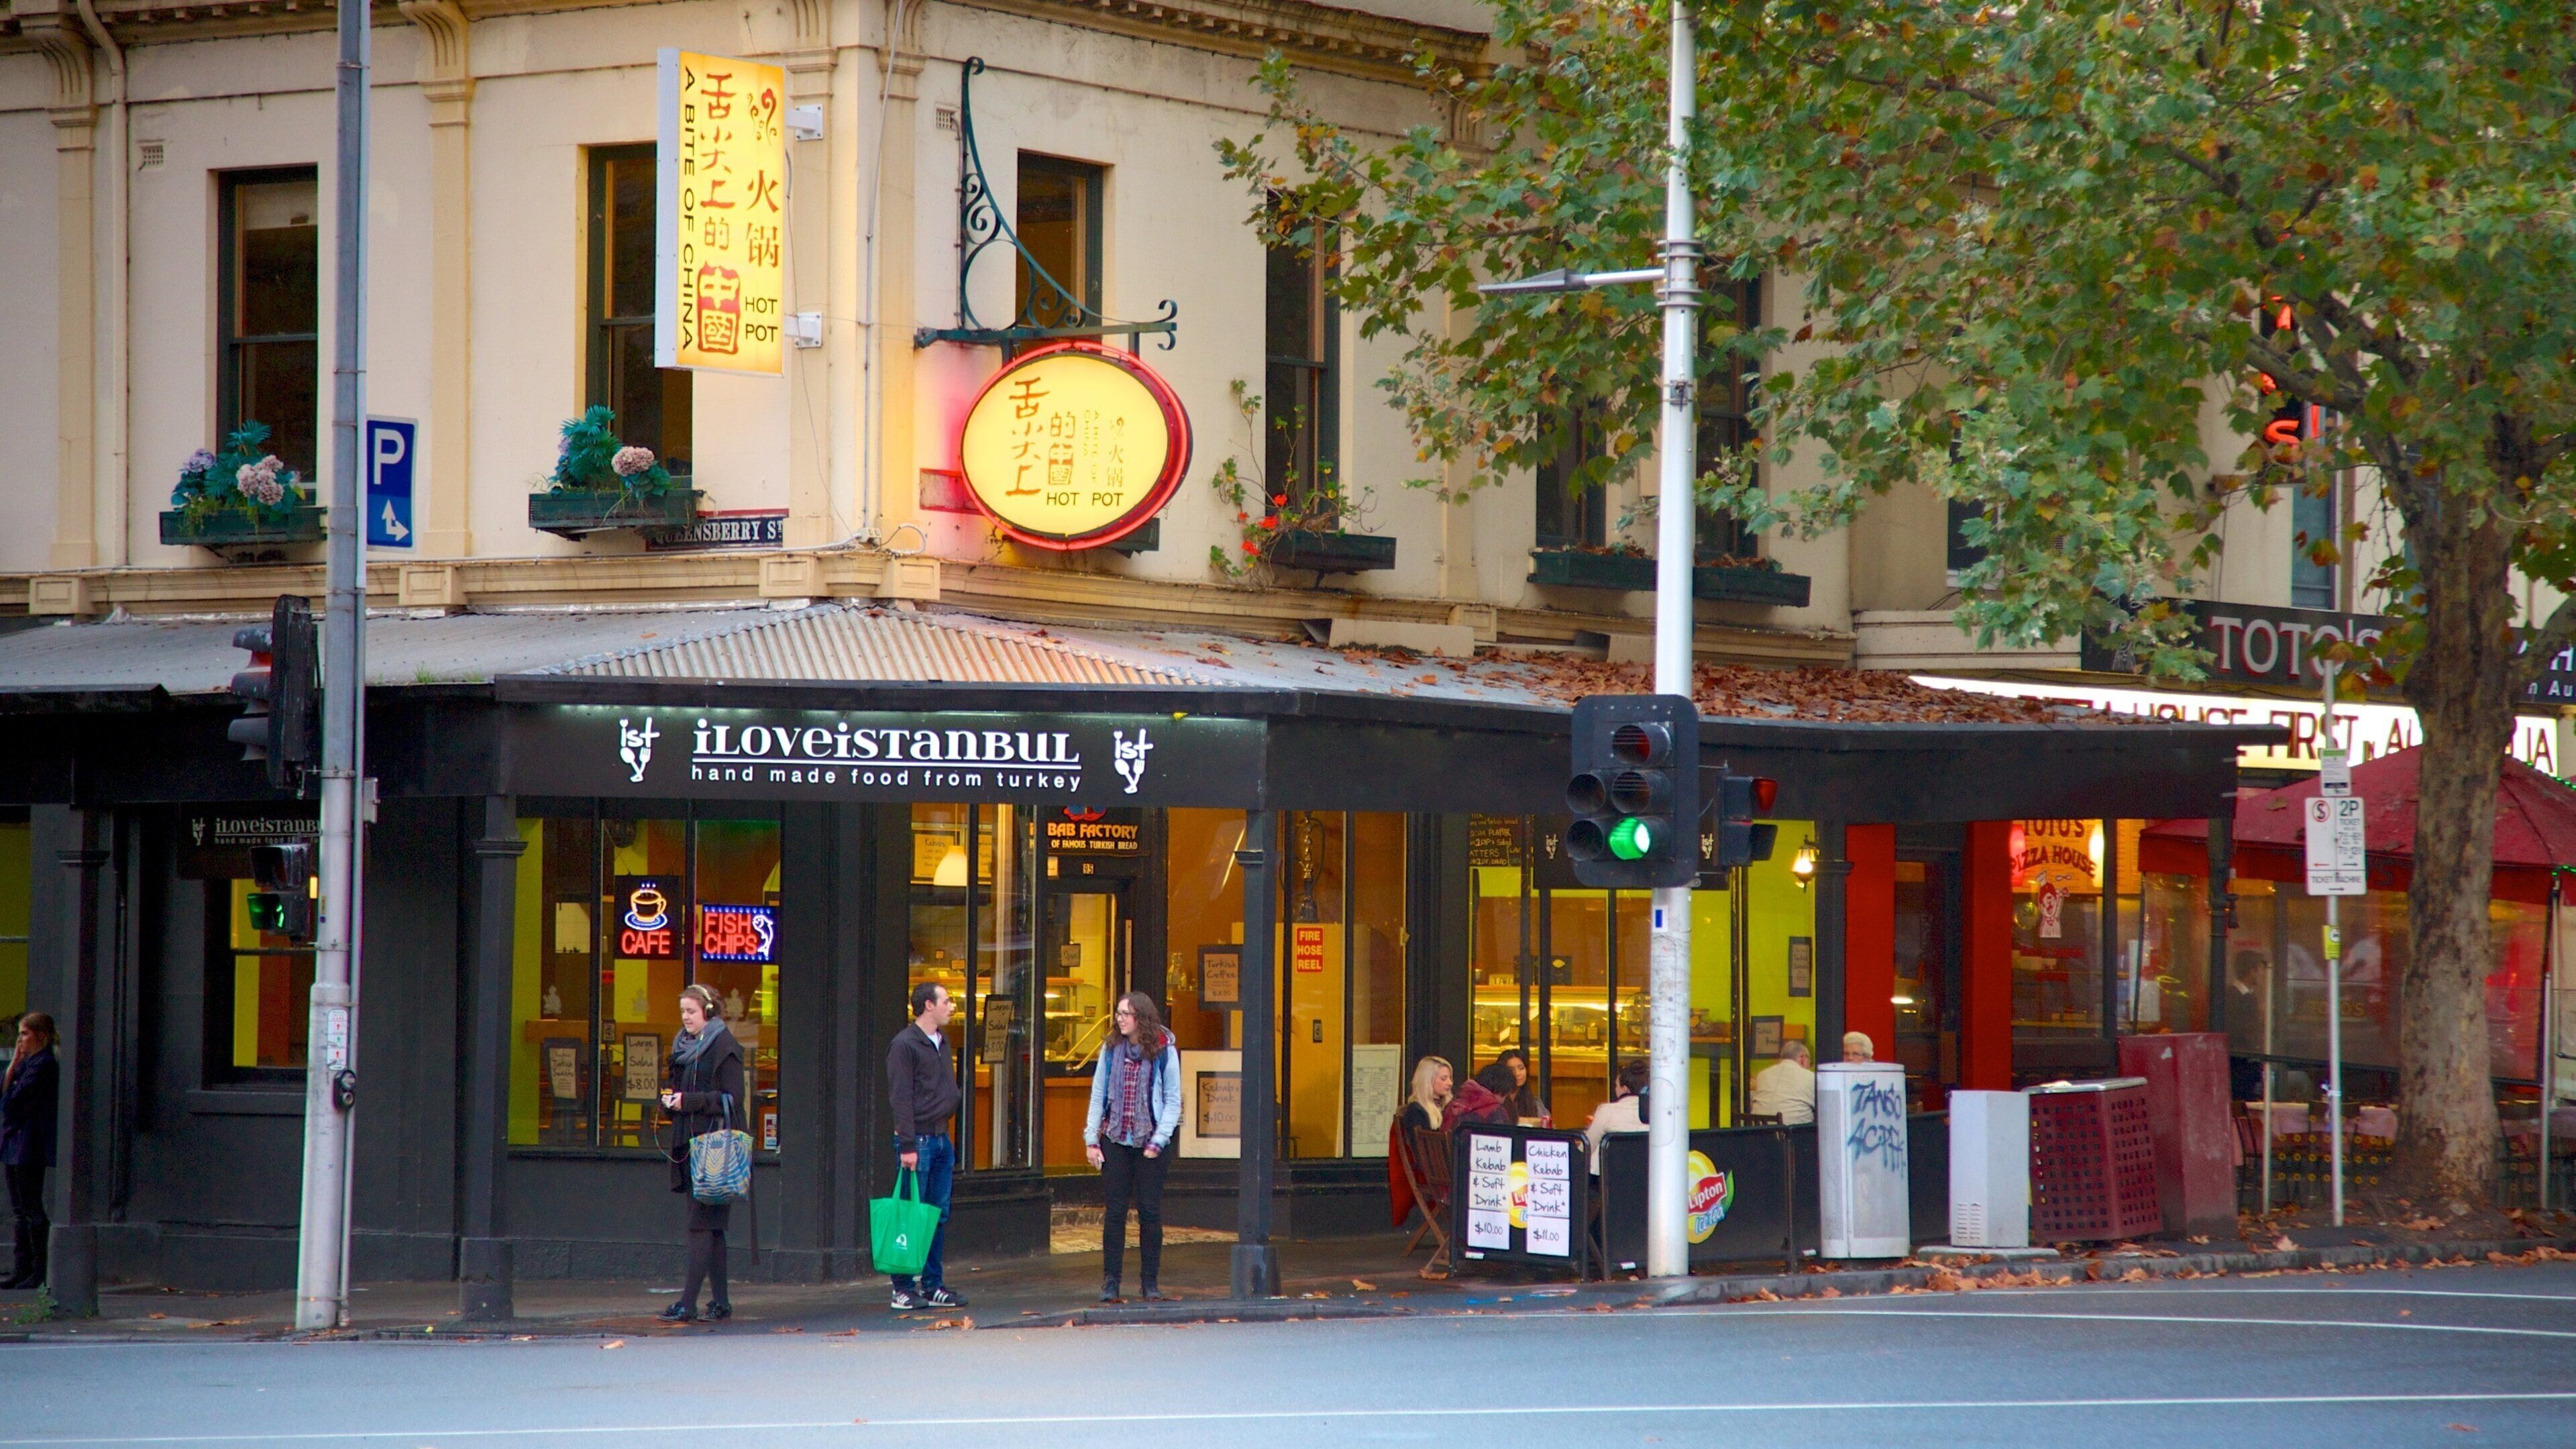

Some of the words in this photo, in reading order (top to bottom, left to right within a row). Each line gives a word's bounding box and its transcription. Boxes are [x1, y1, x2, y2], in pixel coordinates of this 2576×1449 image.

[685, 66, 695, 92] A
[684, 105, 695, 176] BITE
[684, 187, 694, 232] OF
[683, 246, 694, 351] CHINA
[745, 297, 778, 315] HOT
[745, 325, 779, 343] POT
[374, 428, 405, 485] P
[1046, 492, 1080, 506] HOT
[1092, 493, 1124, 506] POT
[692, 765, 753, 782] hand
[770, 768, 836, 784] made
[851, 769, 908, 786] food
[925, 771, 981, 787] from
[998, 772, 1080, 792] turkey
[2340, 800, 2359, 817] 2P
[1079, 824, 1139, 839] FACTORY
[1051, 839, 1061, 849] OF
[1062, 840, 1087, 849] FAMOUS
[1089, 841, 1116, 850] TURKISH
[1118, 841, 1138, 850] BREAD
[1083, 864, 1094, 874] 95
[2052, 845, 2098, 878] HOUSE
[705, 913, 751, 934] FISH
[622, 930, 671, 955] CAFE
[1299, 930, 1321, 941] FIRE
[704, 934, 758, 955] CHIPS
[1297, 945, 1323, 956] HOSE
[1297, 959, 1322, 970] REEL
[1206, 969, 1237, 979] Coffee
[629, 1037, 655, 1052] Large
[627, 1079, 656, 1091] $8.00
[1205, 1093, 1236, 1104] Drink
[1476, 1140, 1502, 1152] Lamb
[1528, 1144, 1568, 1159] Chicken
[1476, 1157, 1507, 1171] Kebab
[1532, 1163, 1563, 1176] Kebab
[1483, 1177, 1505, 1189] Soft
[1540, 1182, 1564, 1195] Soft
[1688, 1181, 1723, 1210] Lipton
[1474, 1222, 1503, 1236] $10.00
[1533, 1229, 1560, 1242] $11.00
